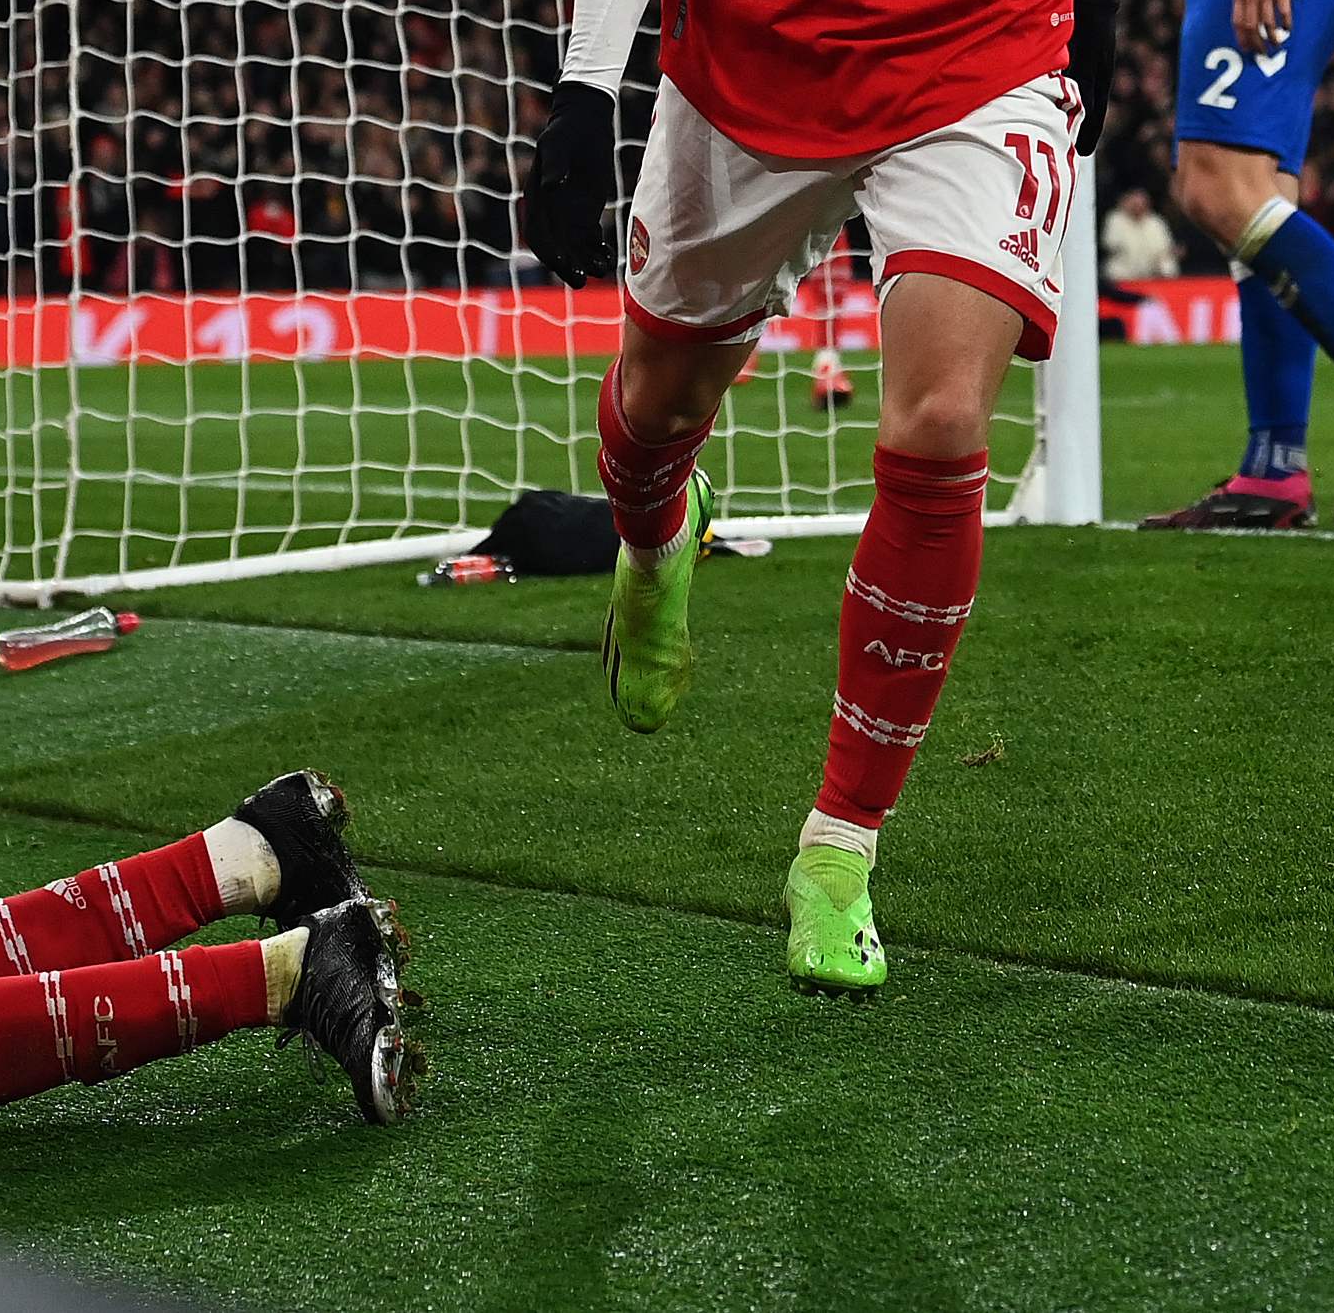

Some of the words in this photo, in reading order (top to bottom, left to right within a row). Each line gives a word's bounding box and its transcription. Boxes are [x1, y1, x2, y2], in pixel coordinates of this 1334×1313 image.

[1197, 46, 1244, 110] 2
[1003, 132, 1061, 236] 11
[999, 237, 1040, 274] adidas
[863, 639, 944, 671] AFC
[94, 995, 121, 1074] AFC
